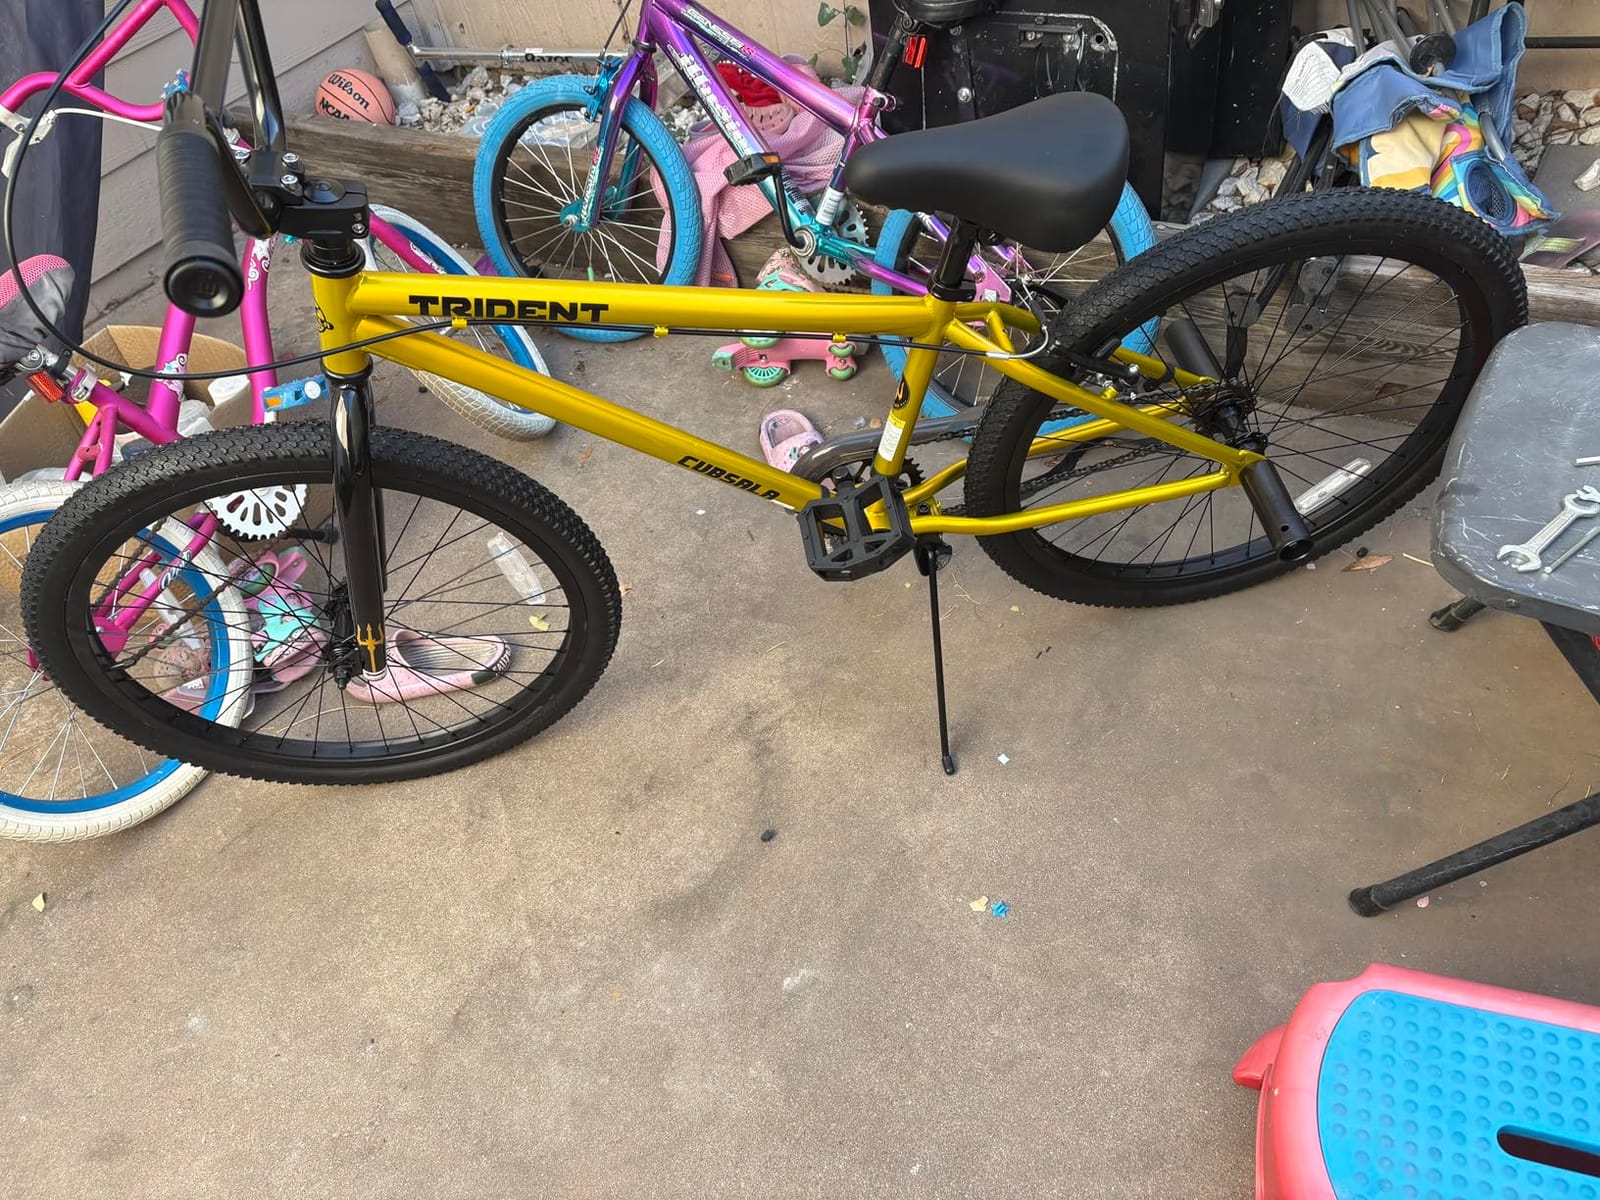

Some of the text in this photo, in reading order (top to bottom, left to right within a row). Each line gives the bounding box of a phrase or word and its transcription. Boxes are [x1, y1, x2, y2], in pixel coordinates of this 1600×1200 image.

[327, 73, 370, 111] Wilson
[408, 294, 609, 323] TRIDENT
[676, 455, 781, 501] CUBSALA
